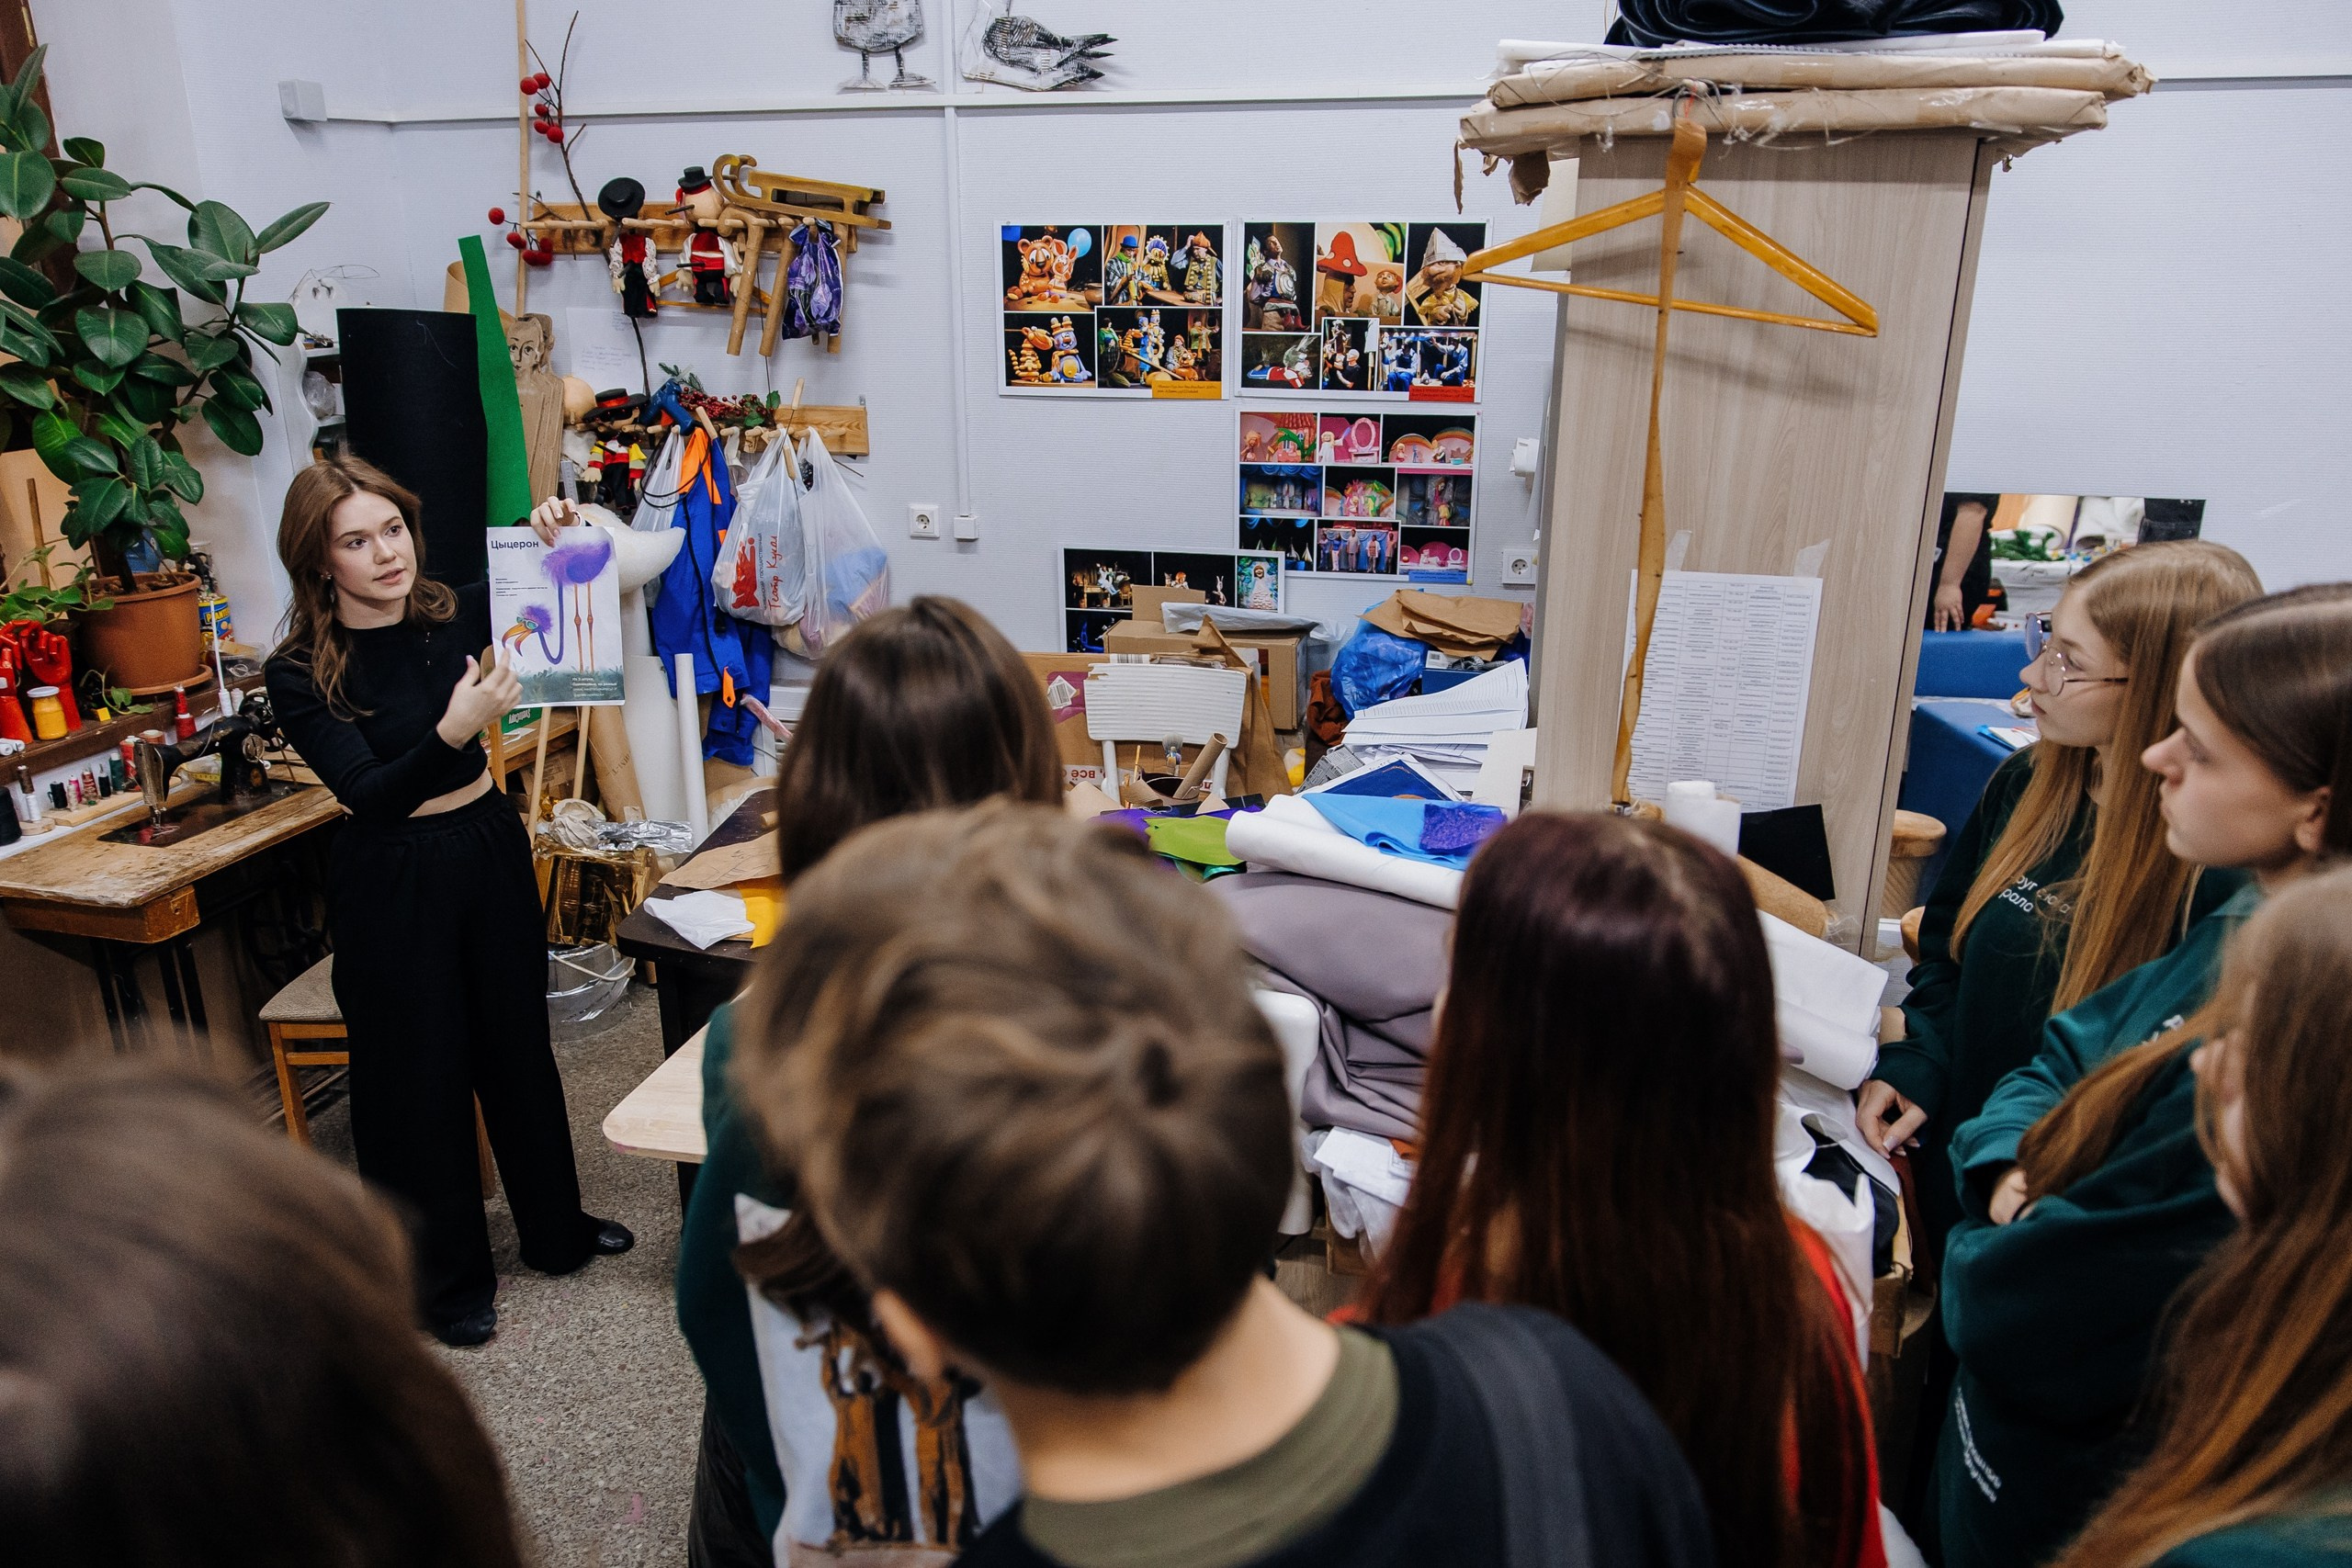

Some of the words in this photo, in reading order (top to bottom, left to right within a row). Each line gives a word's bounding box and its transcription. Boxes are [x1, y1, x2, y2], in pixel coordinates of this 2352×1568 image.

[491, 540, 539, 550] Цыцерон
[766, 536, 783, 569] Кукол
[768, 575, 784, 611] Театр
[1071, 770, 1096, 781] всё
[1997, 888, 2034, 912] рала
